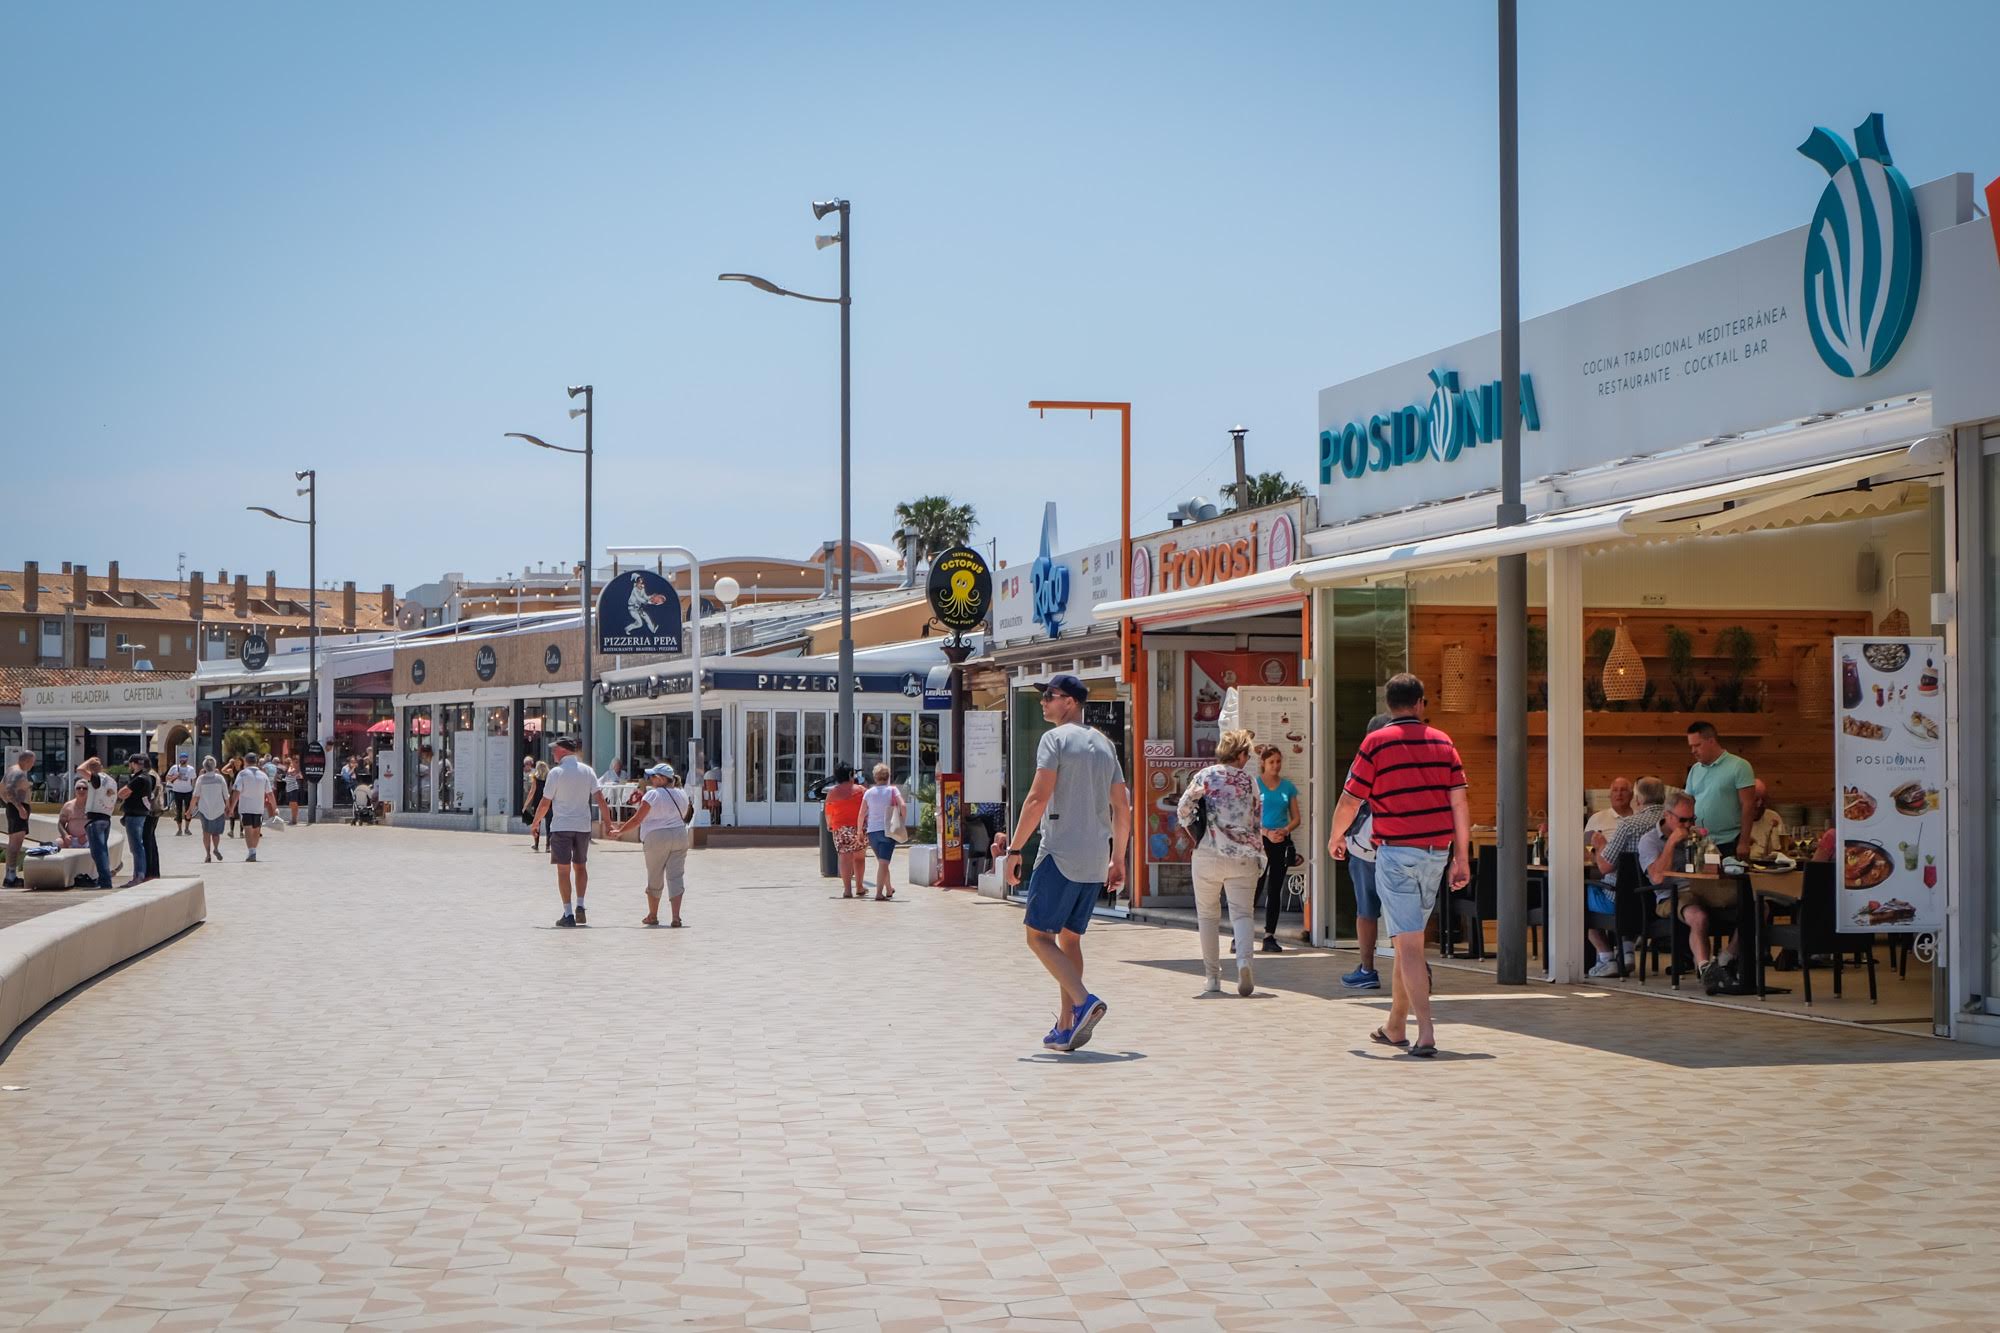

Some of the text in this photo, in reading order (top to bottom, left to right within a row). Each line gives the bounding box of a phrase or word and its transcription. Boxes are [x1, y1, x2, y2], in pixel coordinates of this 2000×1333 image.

[1583, 306, 1788, 376] COCINA TRADICIONAL MEDITERRÁNEA
[1598, 338, 1768, 397] RESTAURANTE COCKTAIL BAR
[941, 559, 984, 574] OCTOPUS
[603, 636, 678, 647] PIZZERIA PEPA
[758, 675, 863, 691] PIZZERA
[36, 692, 54, 704] OLAS
[71, 690, 110, 704] HELADERIA
[123, 687, 162, 701] CAFETERIA
[1149, 760, 1215, 768] EUROFERTAS
